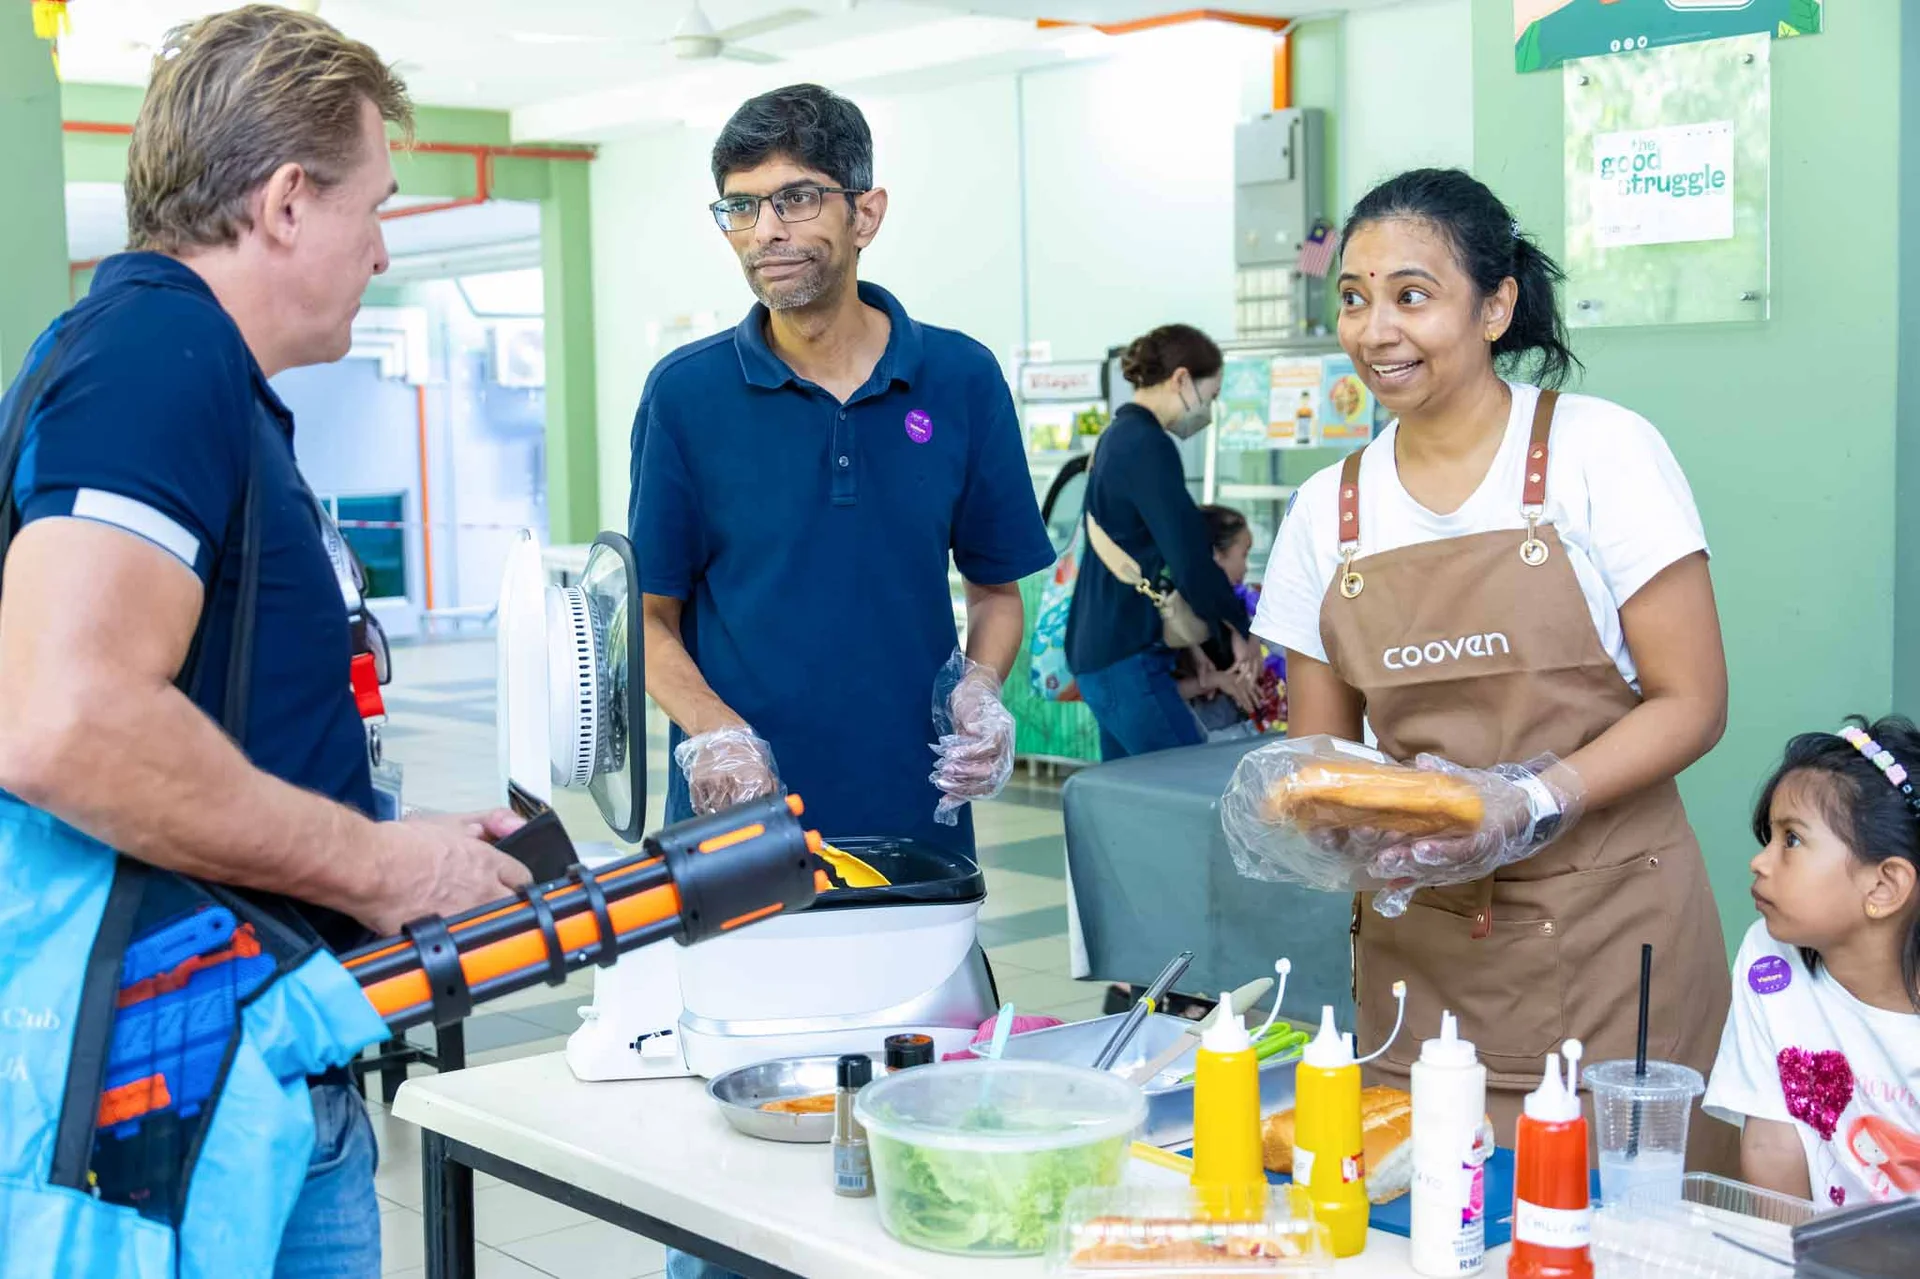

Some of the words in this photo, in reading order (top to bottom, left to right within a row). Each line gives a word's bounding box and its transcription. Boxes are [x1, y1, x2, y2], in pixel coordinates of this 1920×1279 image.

[1631, 136, 1656, 151] the
[1600, 148, 1662, 180] good
[1383, 631, 1510, 670] cooven
